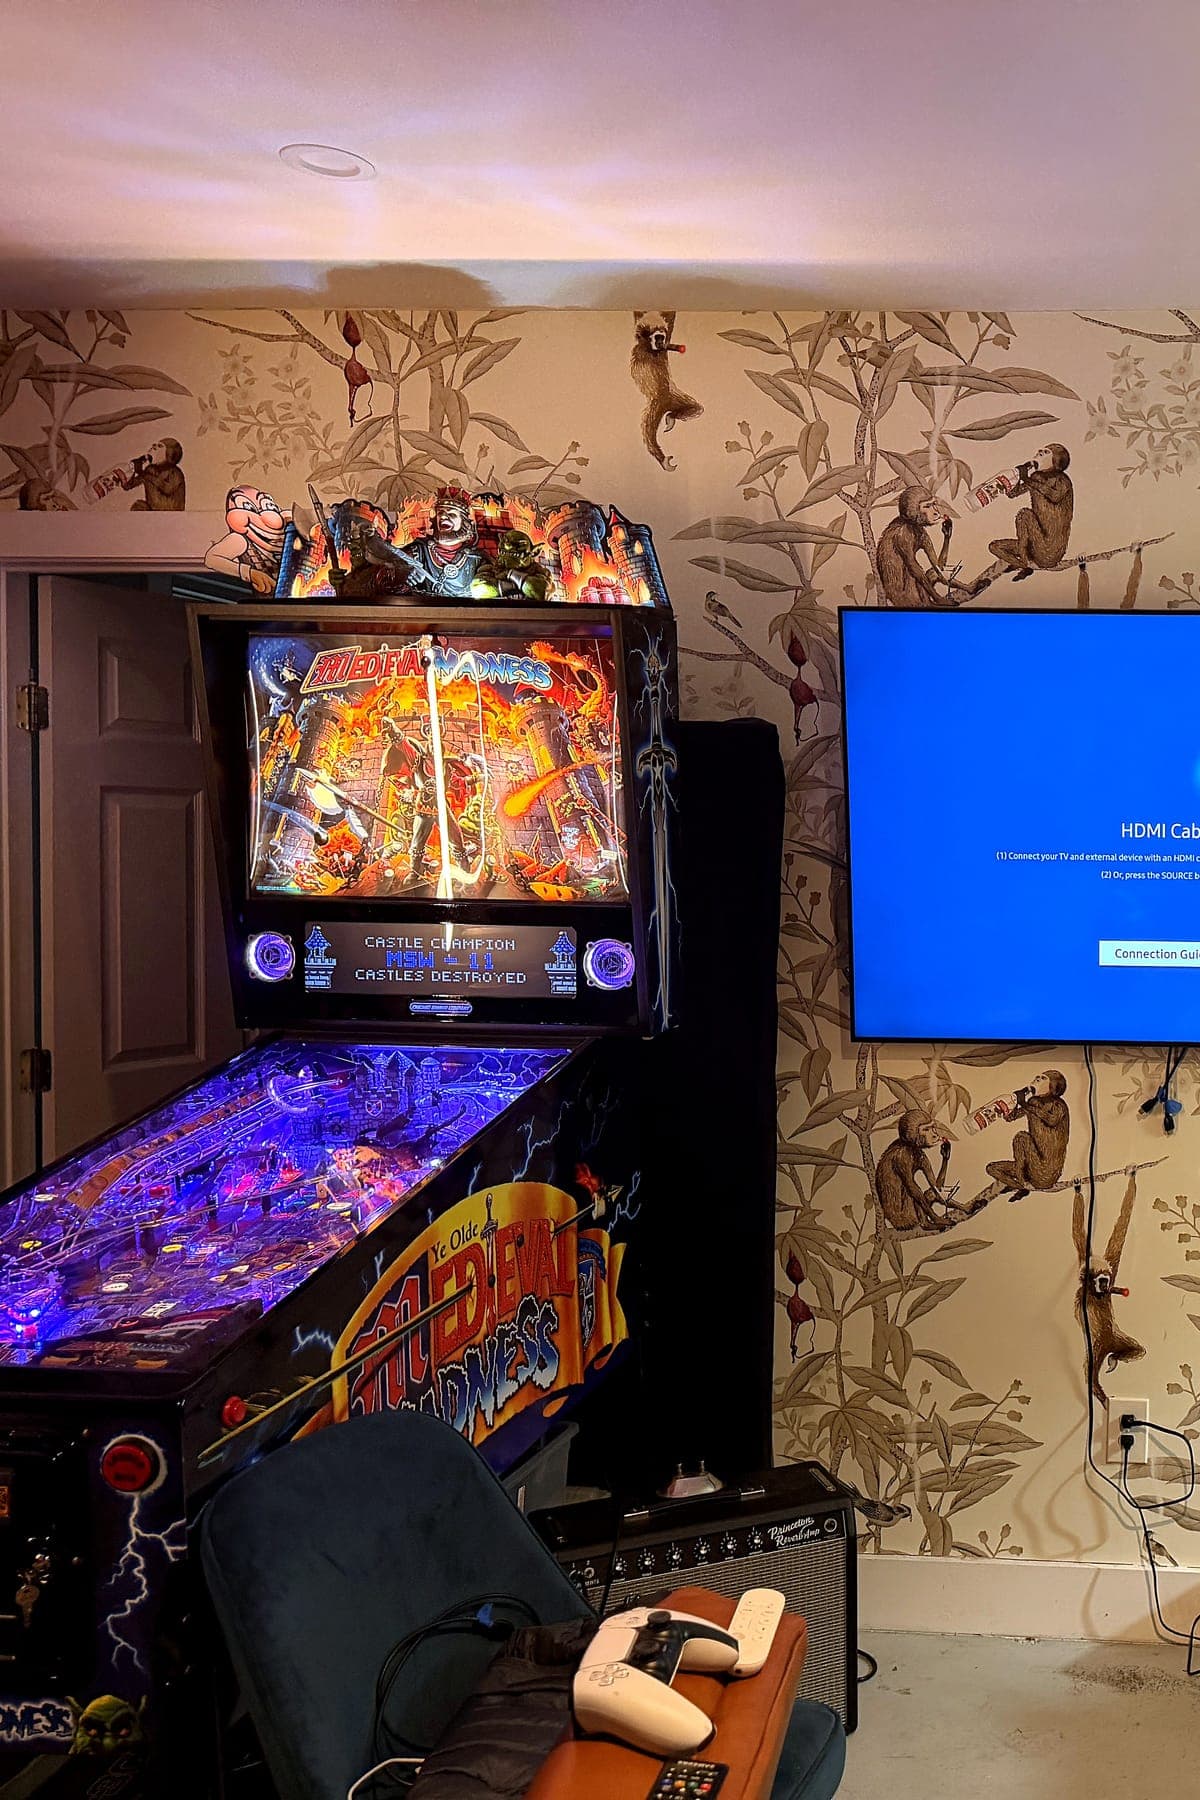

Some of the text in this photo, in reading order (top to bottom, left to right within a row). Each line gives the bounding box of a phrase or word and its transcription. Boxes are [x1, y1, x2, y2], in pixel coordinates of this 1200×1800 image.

[306, 646, 552, 690] MEDIEVA MADNESS
[1121, 822, 1166, 839] HDMI
[997, 851, 1007, 861] (1)
[1009, 851, 1039, 861] Connect
[1041, 852, 1059, 863] your
[1059, 852, 1069, 861] TV
[1070, 852, 1085, 862] and
[1086, 853, 1117, 862] external
[1119, 853, 1143, 862] device
[1144, 853, 1161, 863] with
[1163, 854, 1172, 863] an
[1174, 854, 1194, 863] HDMI
[1101, 870, 1111, 880] (2)
[1113, 870, 1125, 882] Or,
[1125, 872, 1146, 882] press
[1147, 871, 1160, 880] the
[1162, 871, 1193, 881] SOURCE
[364, 936, 516, 951] CASTLE CHAMPION
[385, 950, 435, 969] MSW
[468, 952, 495, 971] 11
[1115, 948, 1177, 961] Connection
[355, 969, 527, 985] CASTLES DESTROYED
[431, 1219, 479, 1264] Ye Olde
[351, 1217, 577, 1415] MEDIEVAL
[401, 1294, 559, 1444] DNESS
[767, 1516, 815, 1540] Princeton
